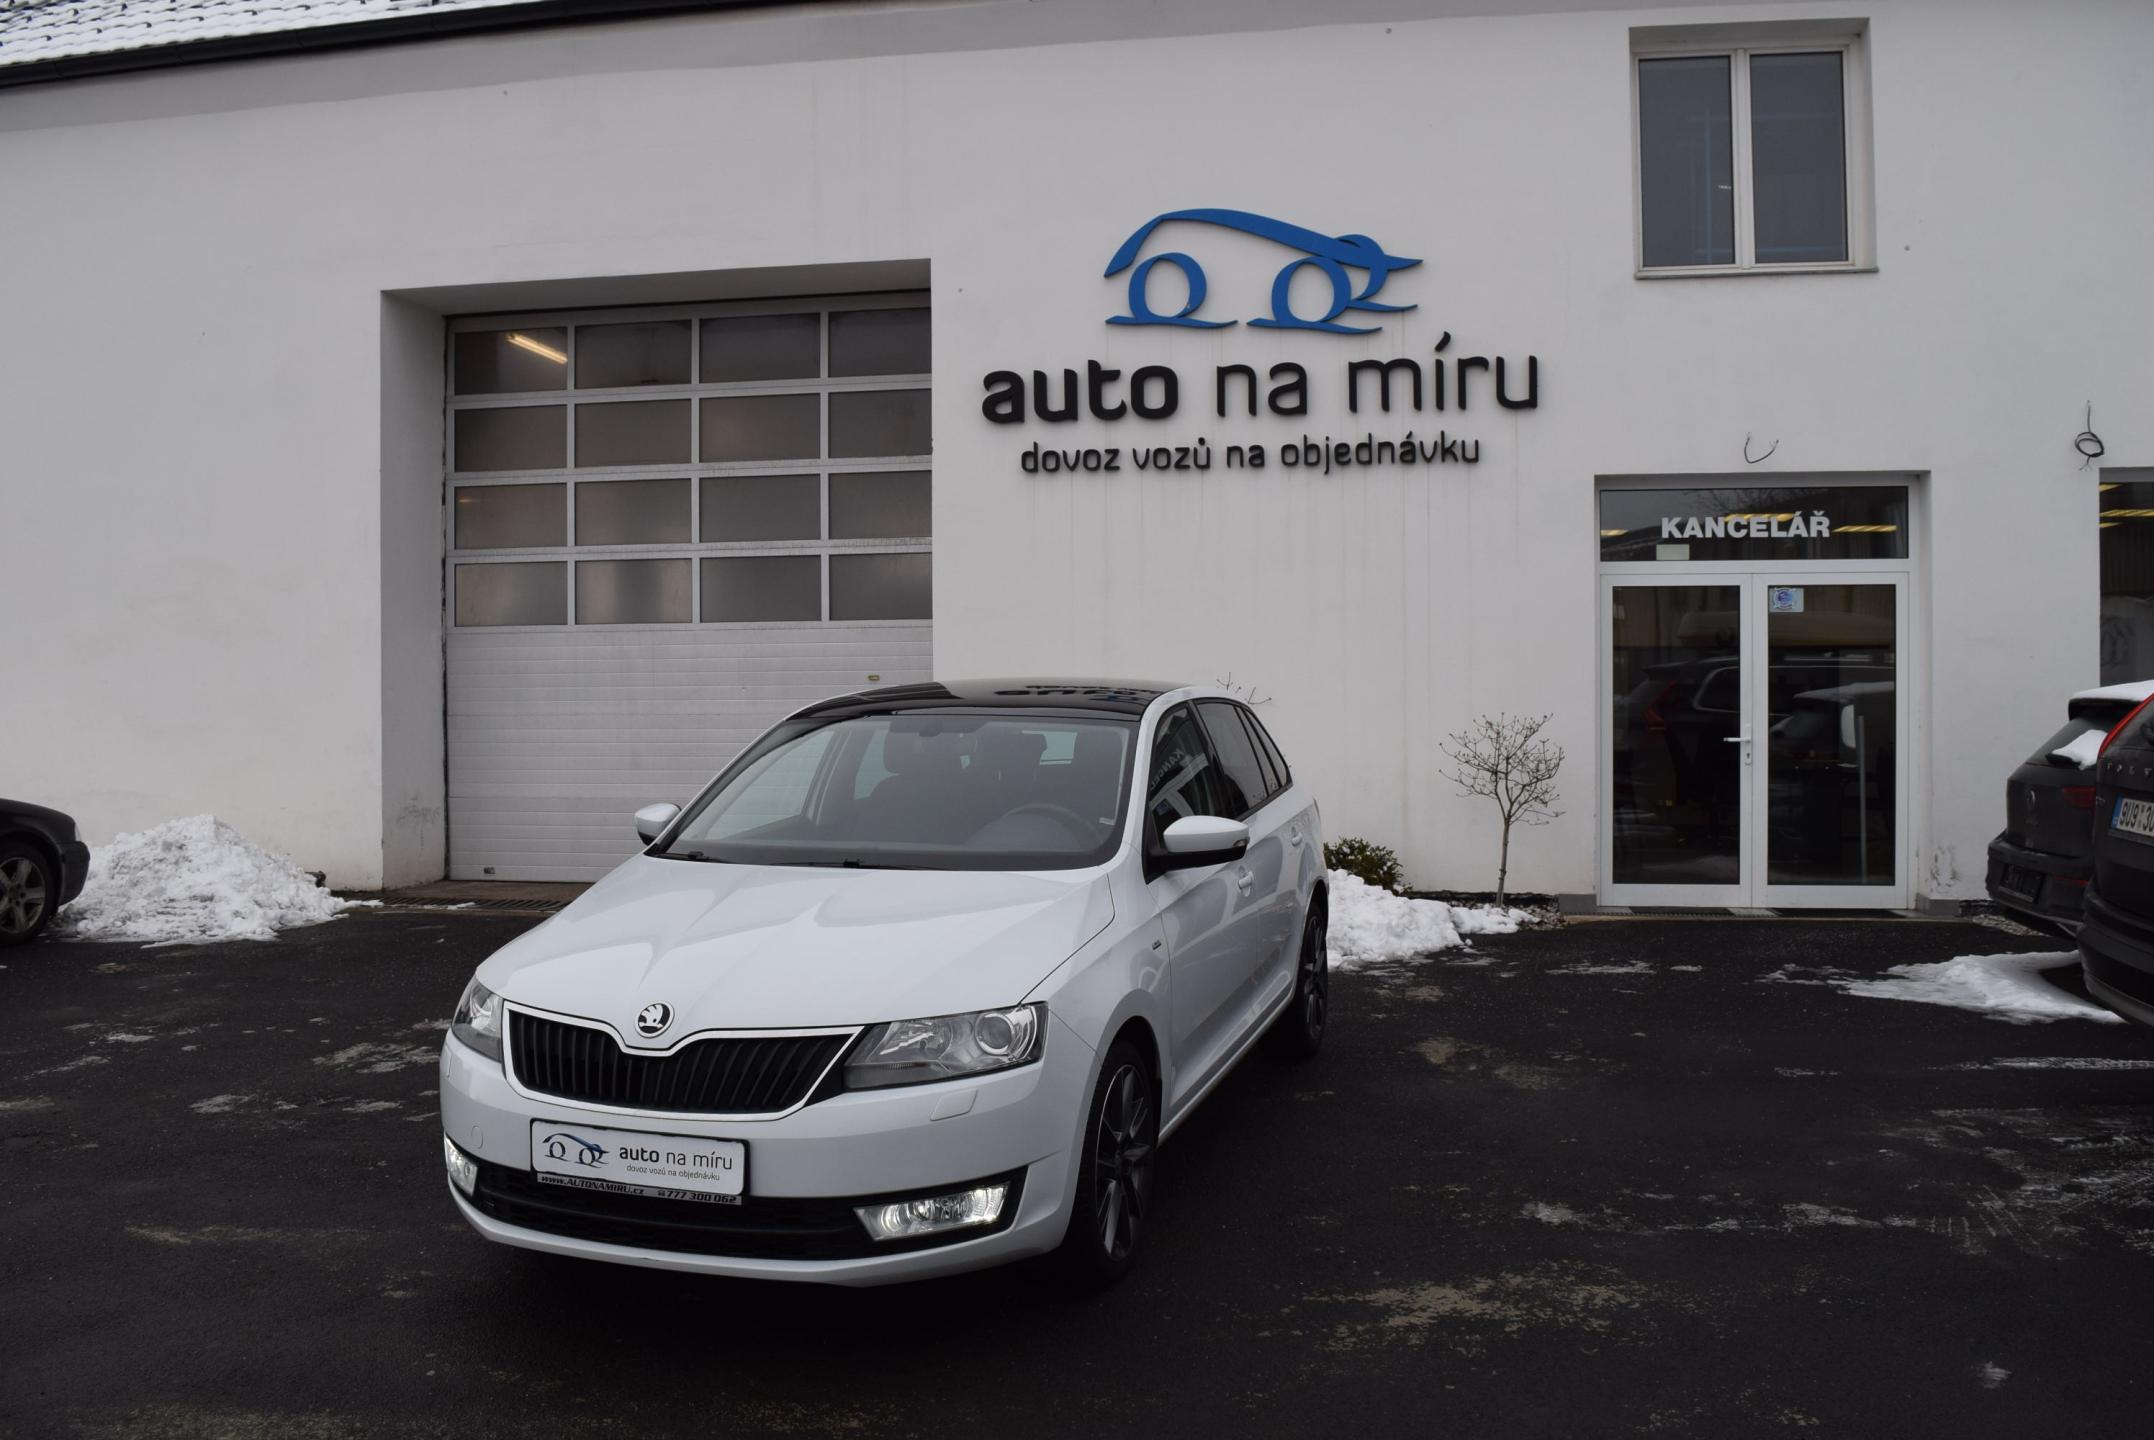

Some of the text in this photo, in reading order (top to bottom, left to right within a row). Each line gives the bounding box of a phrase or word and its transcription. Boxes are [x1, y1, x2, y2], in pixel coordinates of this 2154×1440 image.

[980, 331, 1538, 425] auto na míru
[1021, 430, 1481, 475] dovoz vozů na objednávku
[1661, 511, 1830, 538] KANCELÁŘ
[619, 1146, 733, 1170] auto na míru
[626, 1164, 720, 1181] dovoz vozů na objednávku
